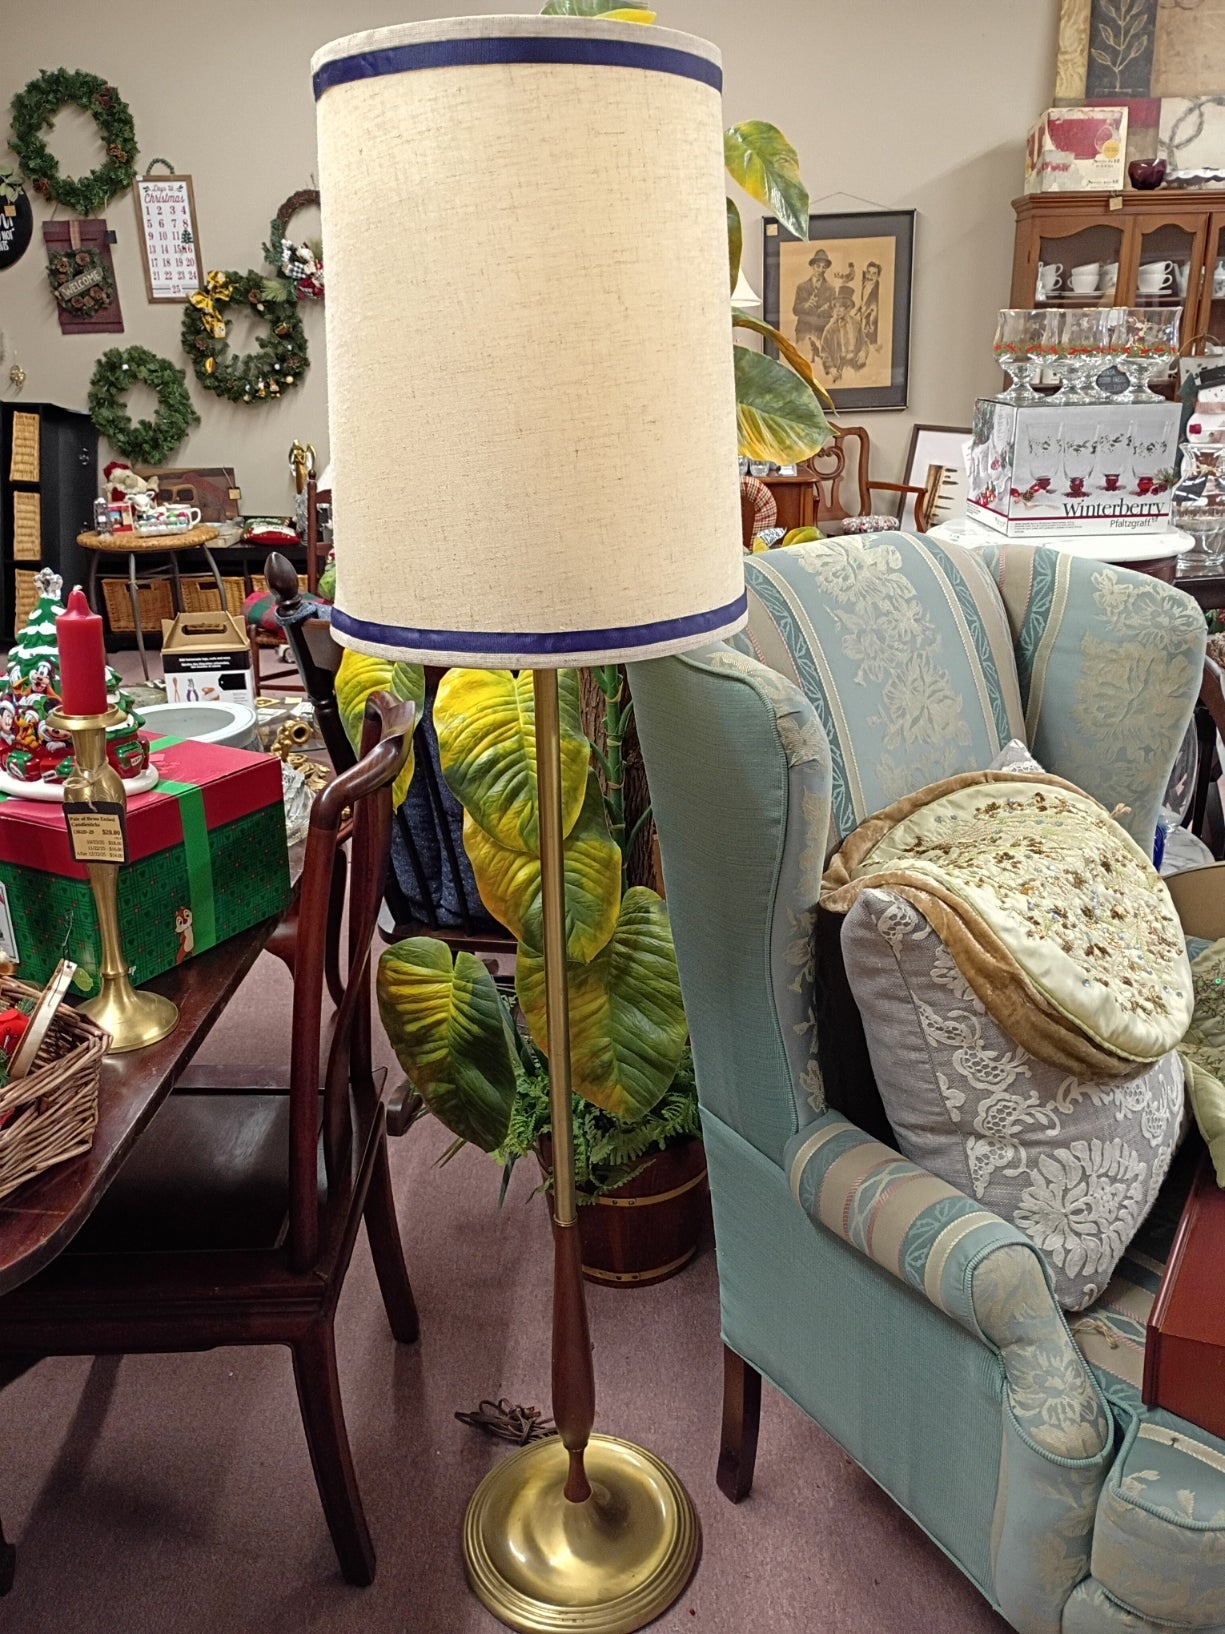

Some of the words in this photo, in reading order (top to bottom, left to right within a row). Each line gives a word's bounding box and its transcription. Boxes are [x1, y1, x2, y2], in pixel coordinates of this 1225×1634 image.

[144, 193, 185, 204] Christmas
[145, 205, 150, 216] 1
[156, 205, 163, 216] 2
[169, 205, 176, 216] 3
[180, 205, 187, 216] 4
[146, 218, 153, 229] 5
[158, 218, 165, 228] 6
[170, 218, 177, 228] 7
[182, 218, 189, 228] 8
[148, 231, 154, 241] 9
[159, 231, 168, 241] 10
[172, 231, 180, 241] 11
[149, 244, 157, 254] 13
[161, 244, 169, 254] 14
[173, 244, 182, 254] 15
[151, 257, 158, 267] 17
[163, 257, 171, 267] 18
[175, 257, 184, 267] 19
[186, 257, 195, 267] 20
[152, 271, 160, 281] 21
[164, 271, 173, 280] 22
[177, 271, 186, 280] 23
[188, 271, 197, 280] 24
[61, 270, 100, 296] WELCOME
[171, 284, 182, 294] 25
[1062, 498, 1165, 517] Winterberry
[1110, 518, 1151, 530] Pfaltzgraff
